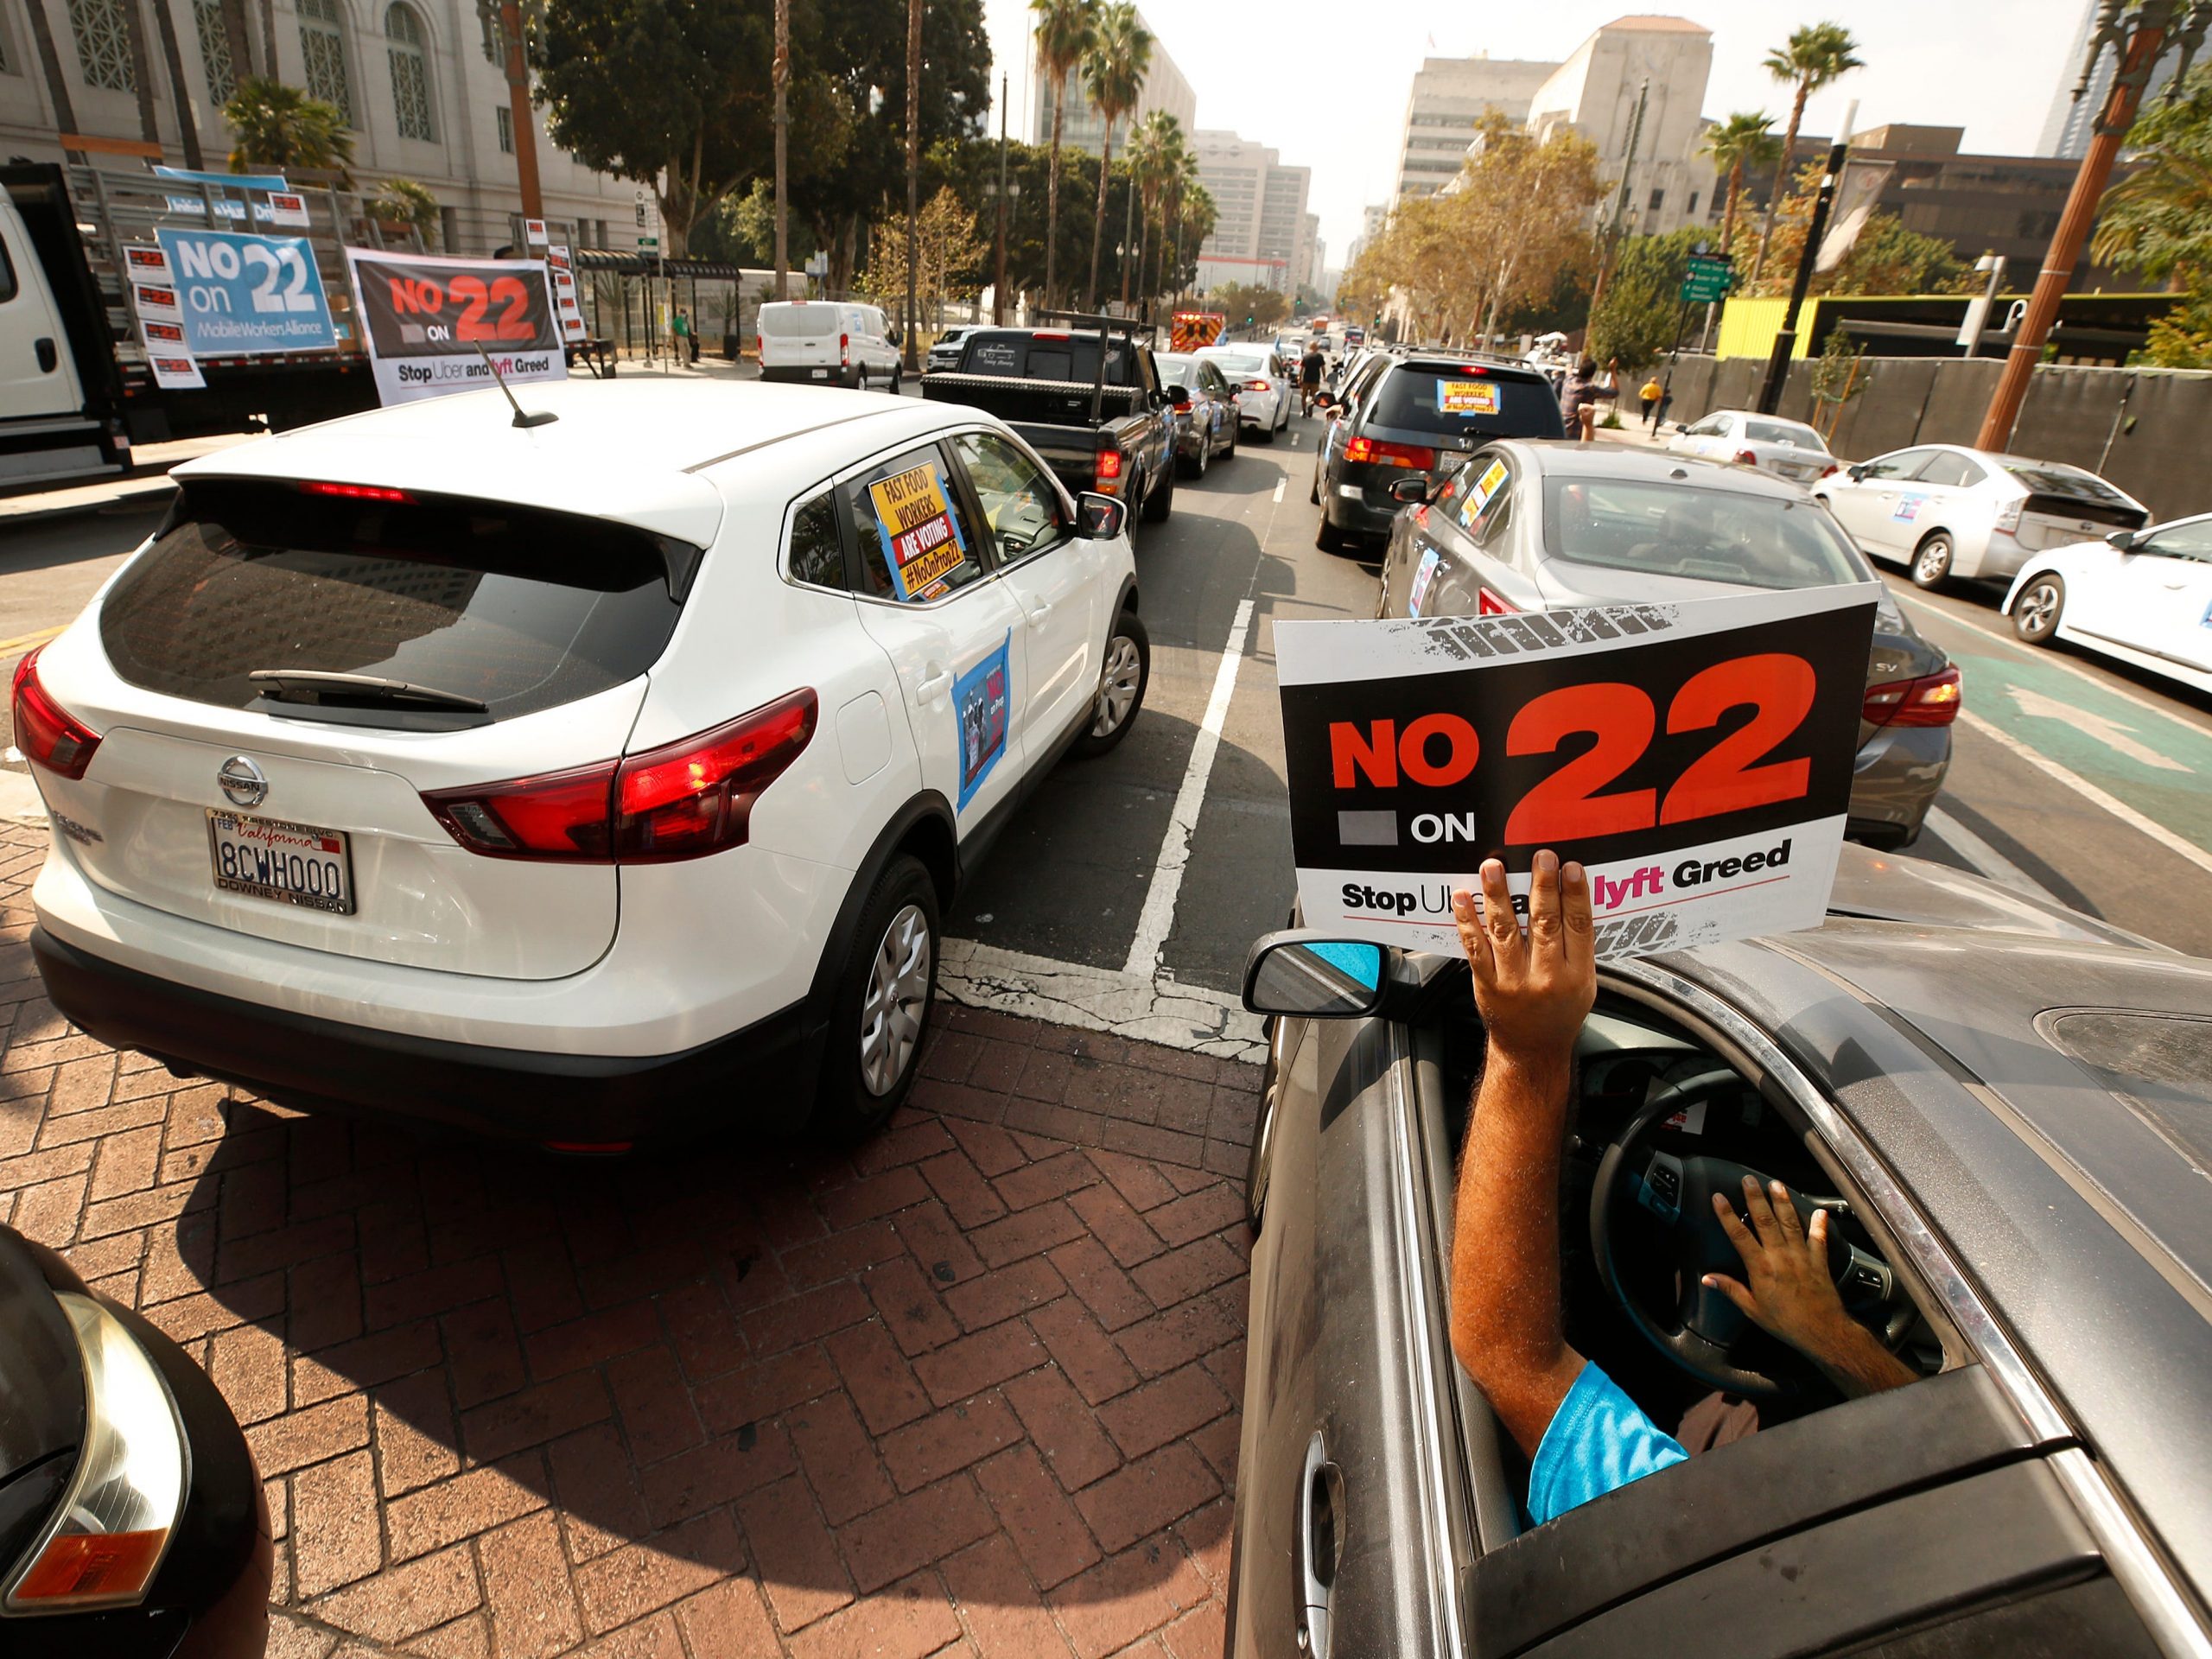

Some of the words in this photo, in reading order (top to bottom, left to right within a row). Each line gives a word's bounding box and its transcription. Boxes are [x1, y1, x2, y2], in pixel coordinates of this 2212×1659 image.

[141, 251, 164, 266] 22
[176, 240, 240, 280] NO
[242, 244, 316, 313] 22
[151, 290, 175, 305] 22
[188, 286, 232, 313] on
[388, 278, 442, 315] NO
[448, 276, 537, 342] 22
[159, 326, 181, 340] 22
[197, 322, 240, 338] Mobile
[240, 321, 284, 336] Workers
[284, 320, 322, 335] Alliance
[427, 325, 449, 340] ON
[398, 364, 432, 382] Stop
[432, 361, 464, 379] Uber
[467, 359, 489, 377] and
[515, 358, 549, 372] Greed
[883, 478, 906, 505] FAST
[904, 468, 929, 495] FOOD
[895, 494, 937, 530] WORKERS
[900, 535, 919, 561] ARE
[918, 517, 949, 549] VOTING
[906, 540, 960, 589] #NoOnProp22
[1876, 663, 1897, 672] SV
[1329, 713, 1479, 788] NO
[1504, 652, 1816, 845] 22
[219, 778, 260, 791] NISSAN
[238, 822, 322, 851] California
[1410, 811, 1475, 842] ON
[220, 841, 340, 899] 8CWH000
[1342, 883, 1417, 916] Stop
[1594, 866, 1664, 910] lyft
[1672, 838, 1792, 888] Greed
[218, 877, 283, 901] DOWNEY
[289, 893, 347, 913] NISSAN
